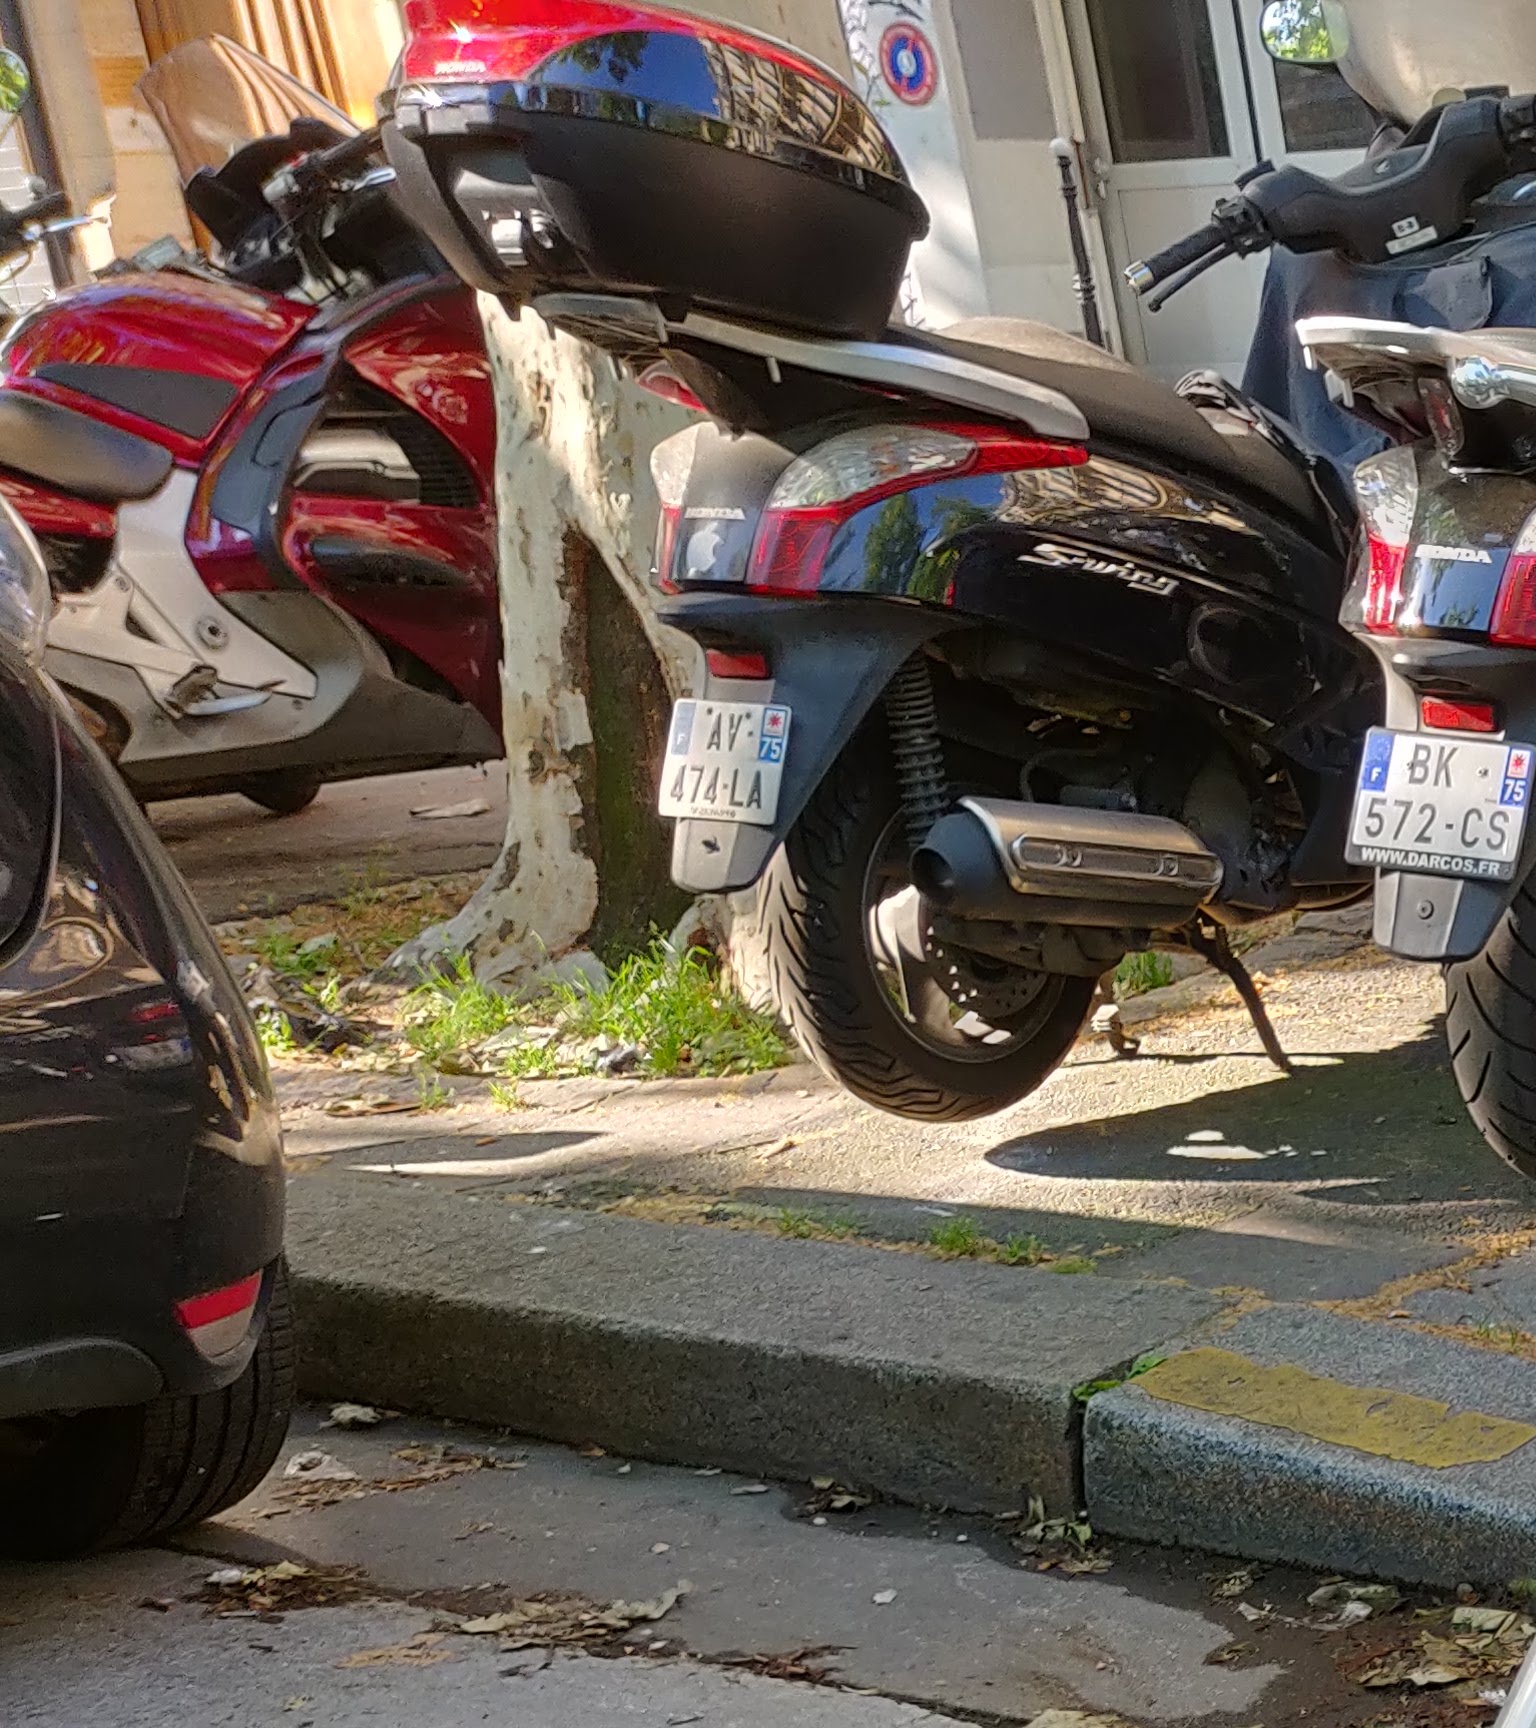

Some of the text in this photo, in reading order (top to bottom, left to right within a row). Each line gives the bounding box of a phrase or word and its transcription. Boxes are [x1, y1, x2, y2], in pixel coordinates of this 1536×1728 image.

[1414, 544, 1492, 564] HONDA
[760, 738, 782, 760] 75
[1370, 766, 1382, 782] F
[1408, 743, 1458, 788] BK
[670, 764, 762, 809] 474-LA
[1503, 779, 1526, 802] 75
[1365, 797, 1510, 850] 572-CS
[1361, 847, 1501, 876] WWW.DARCOS.FR
